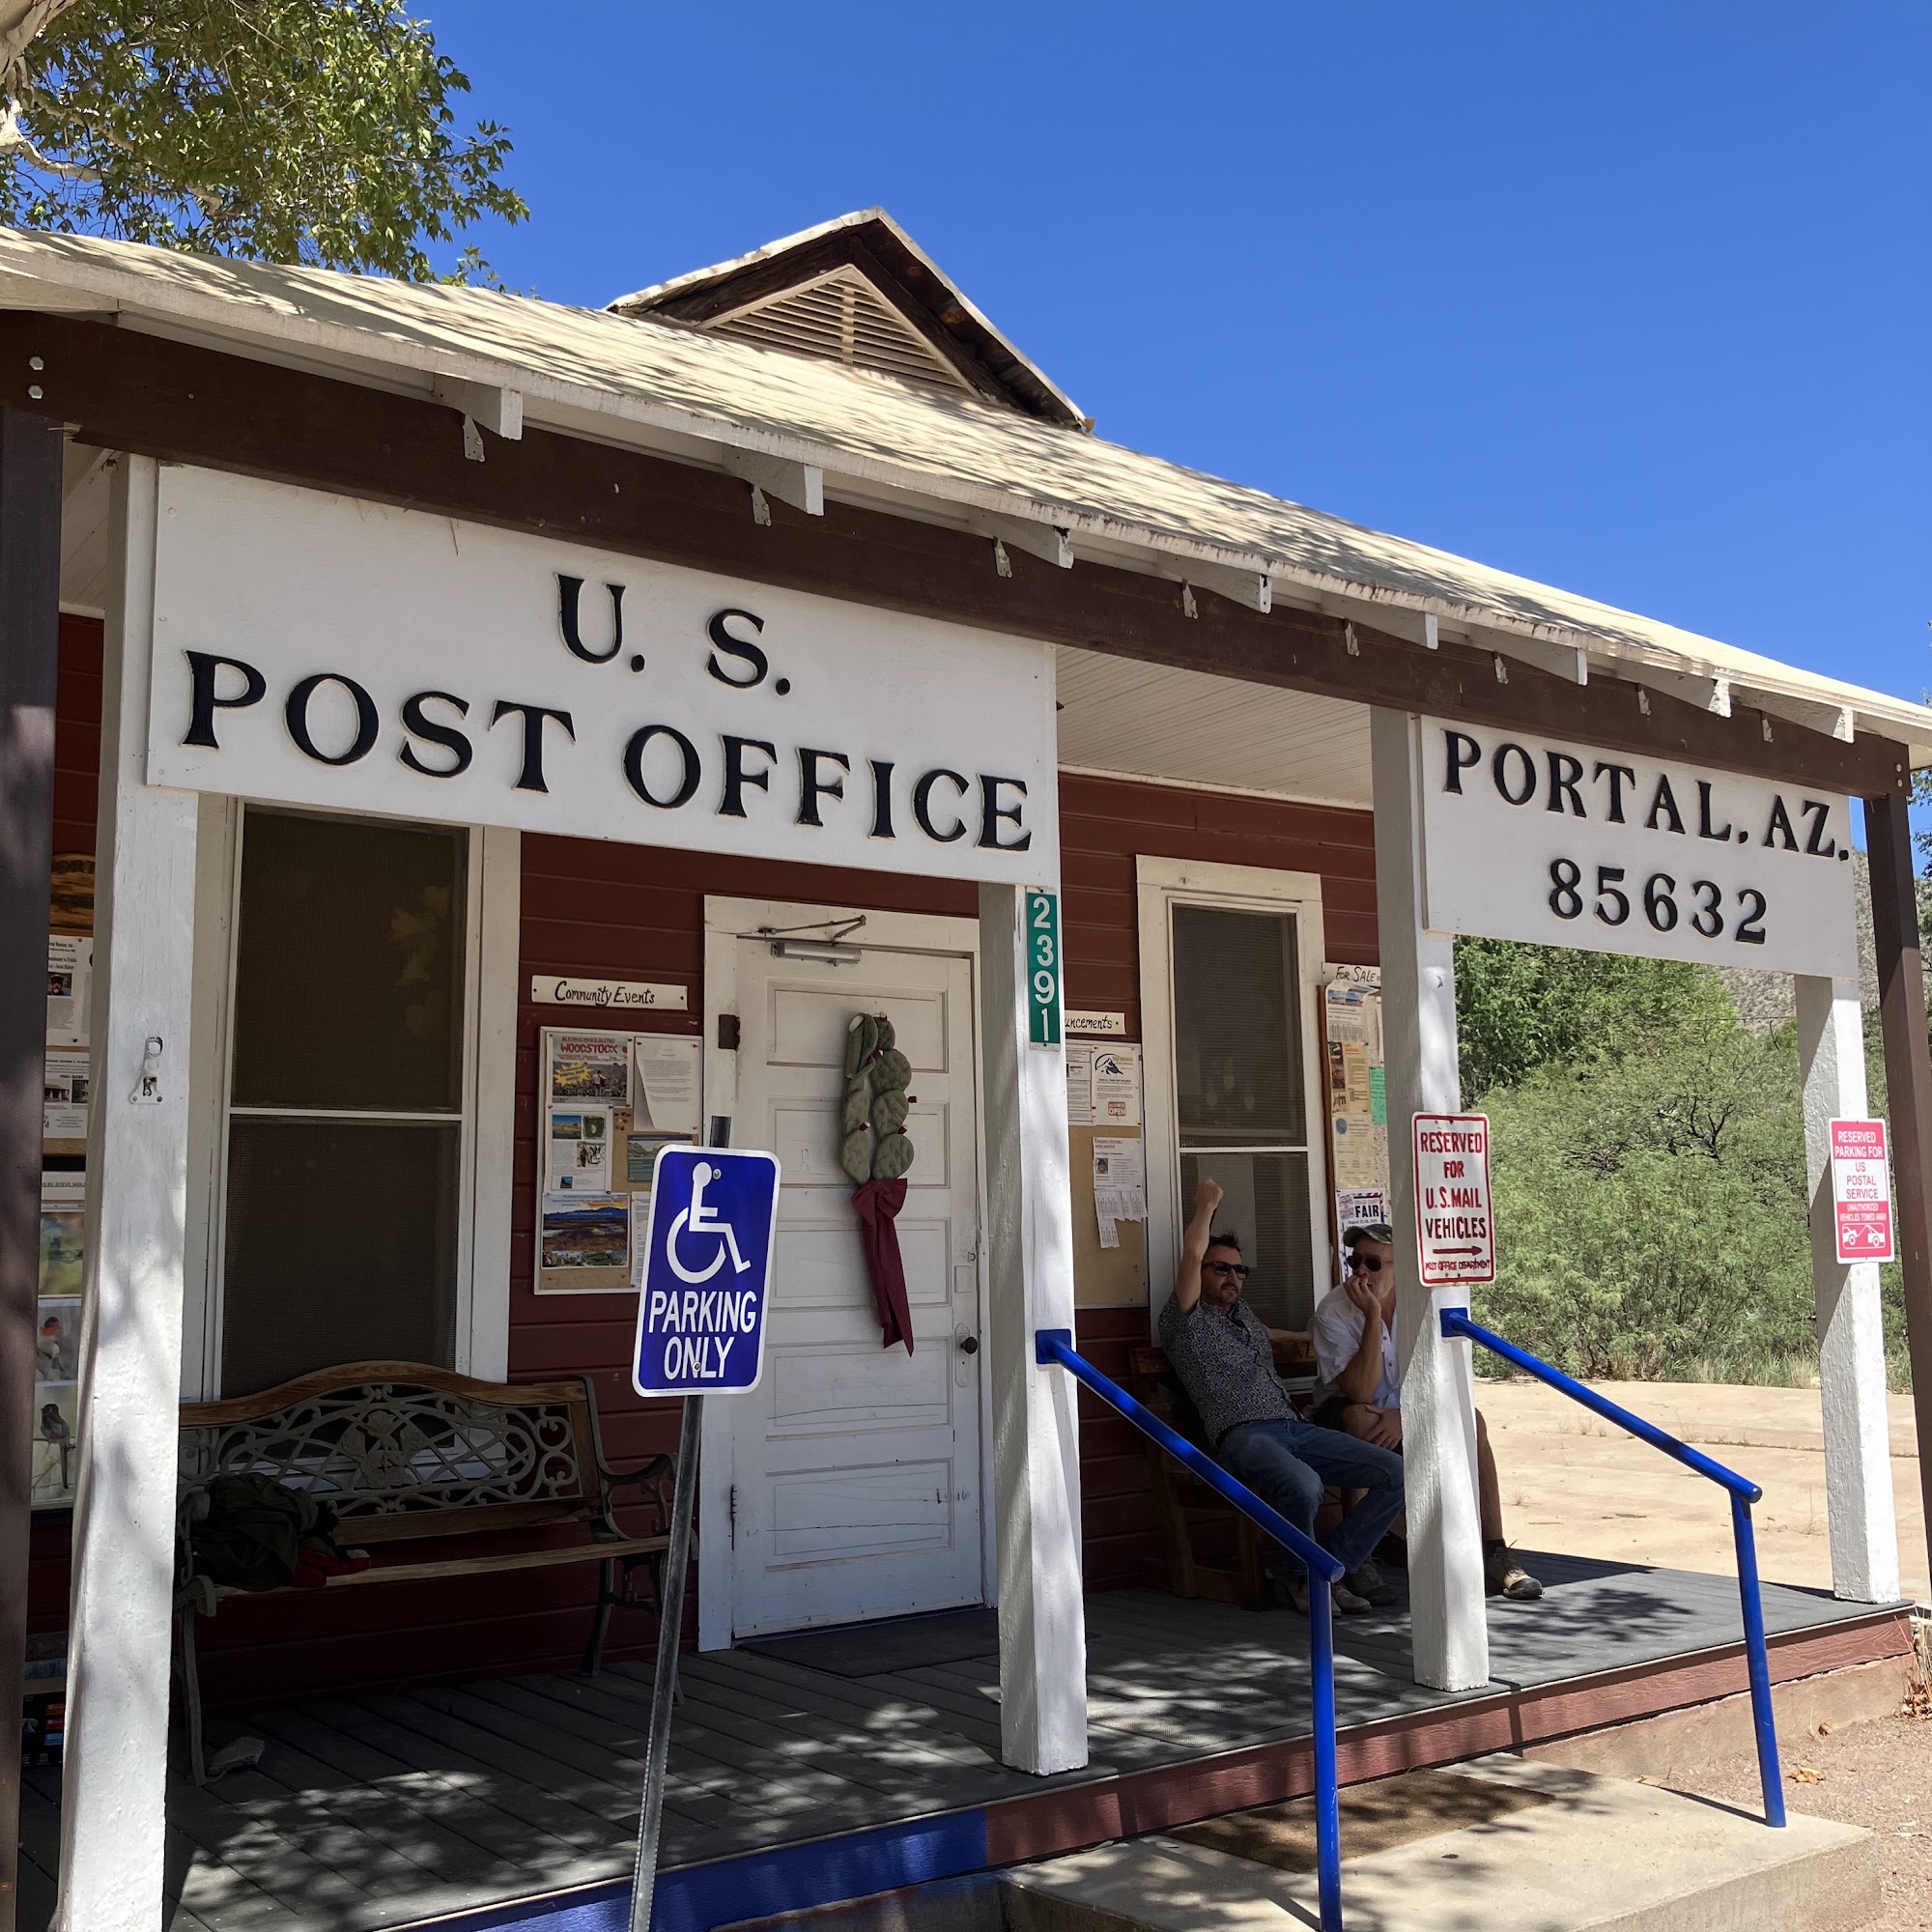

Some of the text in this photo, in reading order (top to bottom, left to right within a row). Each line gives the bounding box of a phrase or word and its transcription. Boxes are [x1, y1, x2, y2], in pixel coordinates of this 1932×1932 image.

[554, 573, 791, 696] U. S.
[180, 649, 1032, 851] POST OFFICE
[1763, 794, 1850, 862] AZ.
[1548, 858, 1767, 945] 85632
[1033, 896, 1056, 1041] 2391
[554, 980, 655, 1007] Community Events
[560, 1043, 618, 1054] WOODSTOCK
[1420, 1131, 1482, 1153] RESERVED
[1837, 1130, 1876, 1144] RESERVED
[1834, 1146, 1883, 1157] PARKING FOR
[1443, 1160, 1464, 1179] FOR
[1855, 1162, 1865, 1172] US
[1846, 1175, 1876, 1185] POSTAL
[1846, 1188, 1879, 1199] SERVICE
[1354, 1205, 1379, 1217] FAIR
[1425, 1216, 1487, 1239] VEHICLES
[648, 1290, 757, 1333] PARKING
[664, 1336, 735, 1380] ONLY
